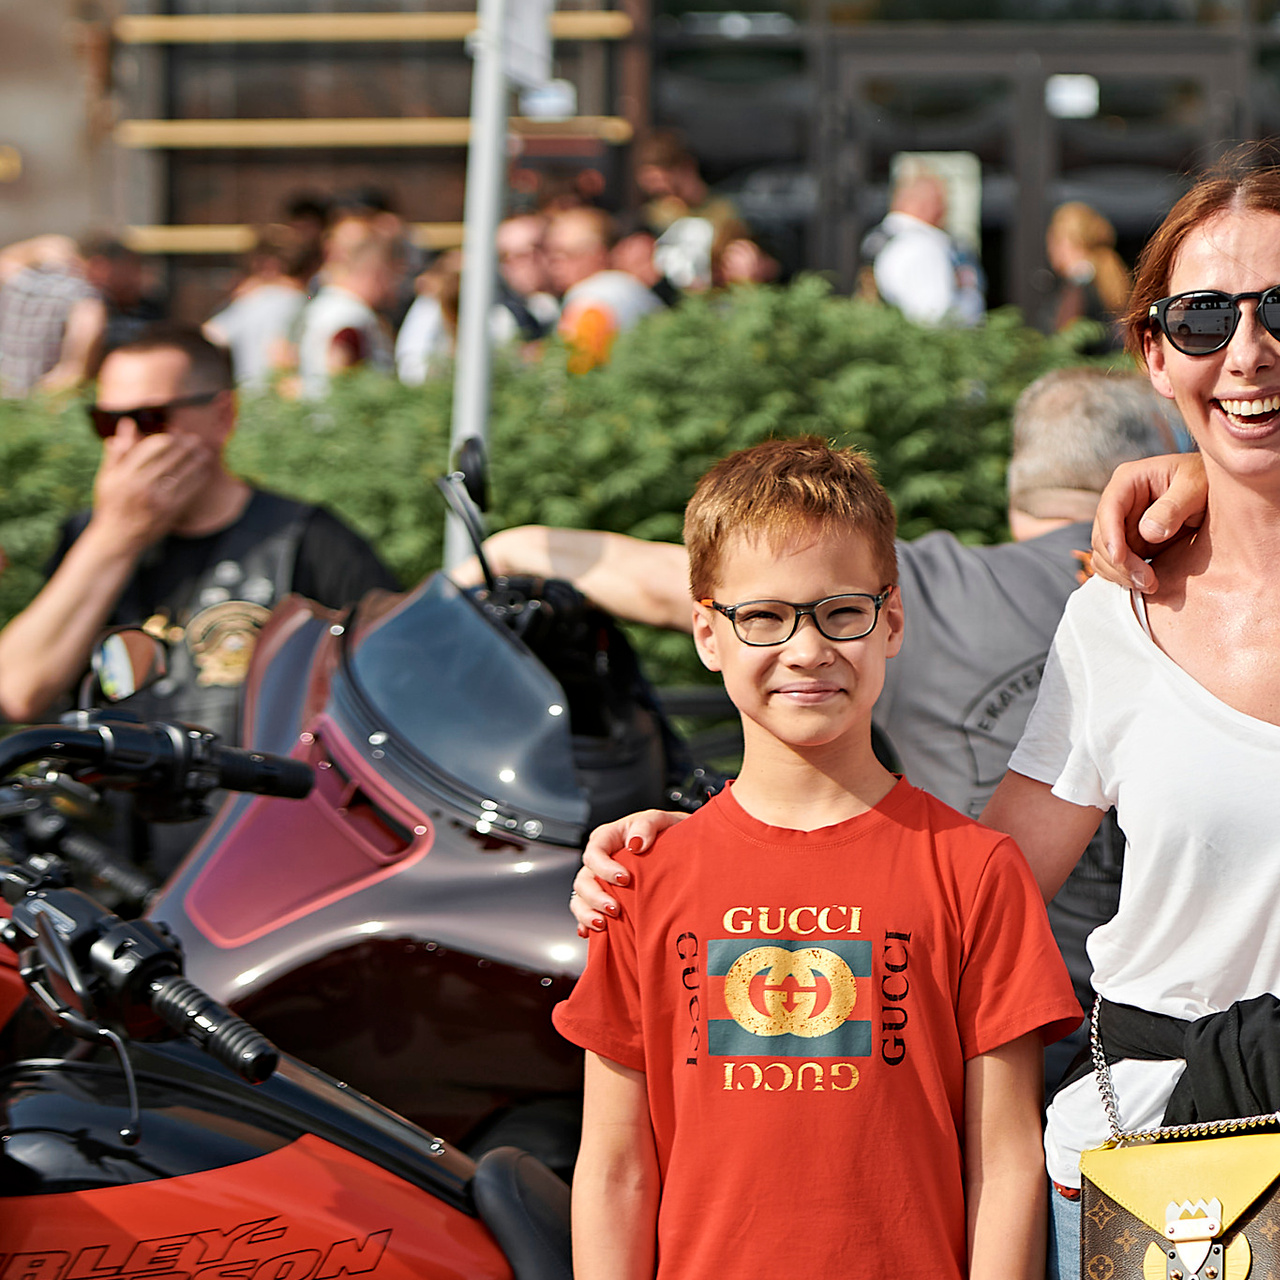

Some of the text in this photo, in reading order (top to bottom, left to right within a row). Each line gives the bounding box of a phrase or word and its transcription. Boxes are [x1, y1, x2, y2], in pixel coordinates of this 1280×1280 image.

[722, 905, 862, 934] GUCCI
[882, 930, 912, 1066] GUCCI
[723, 1062, 860, 1091] GUCCI
